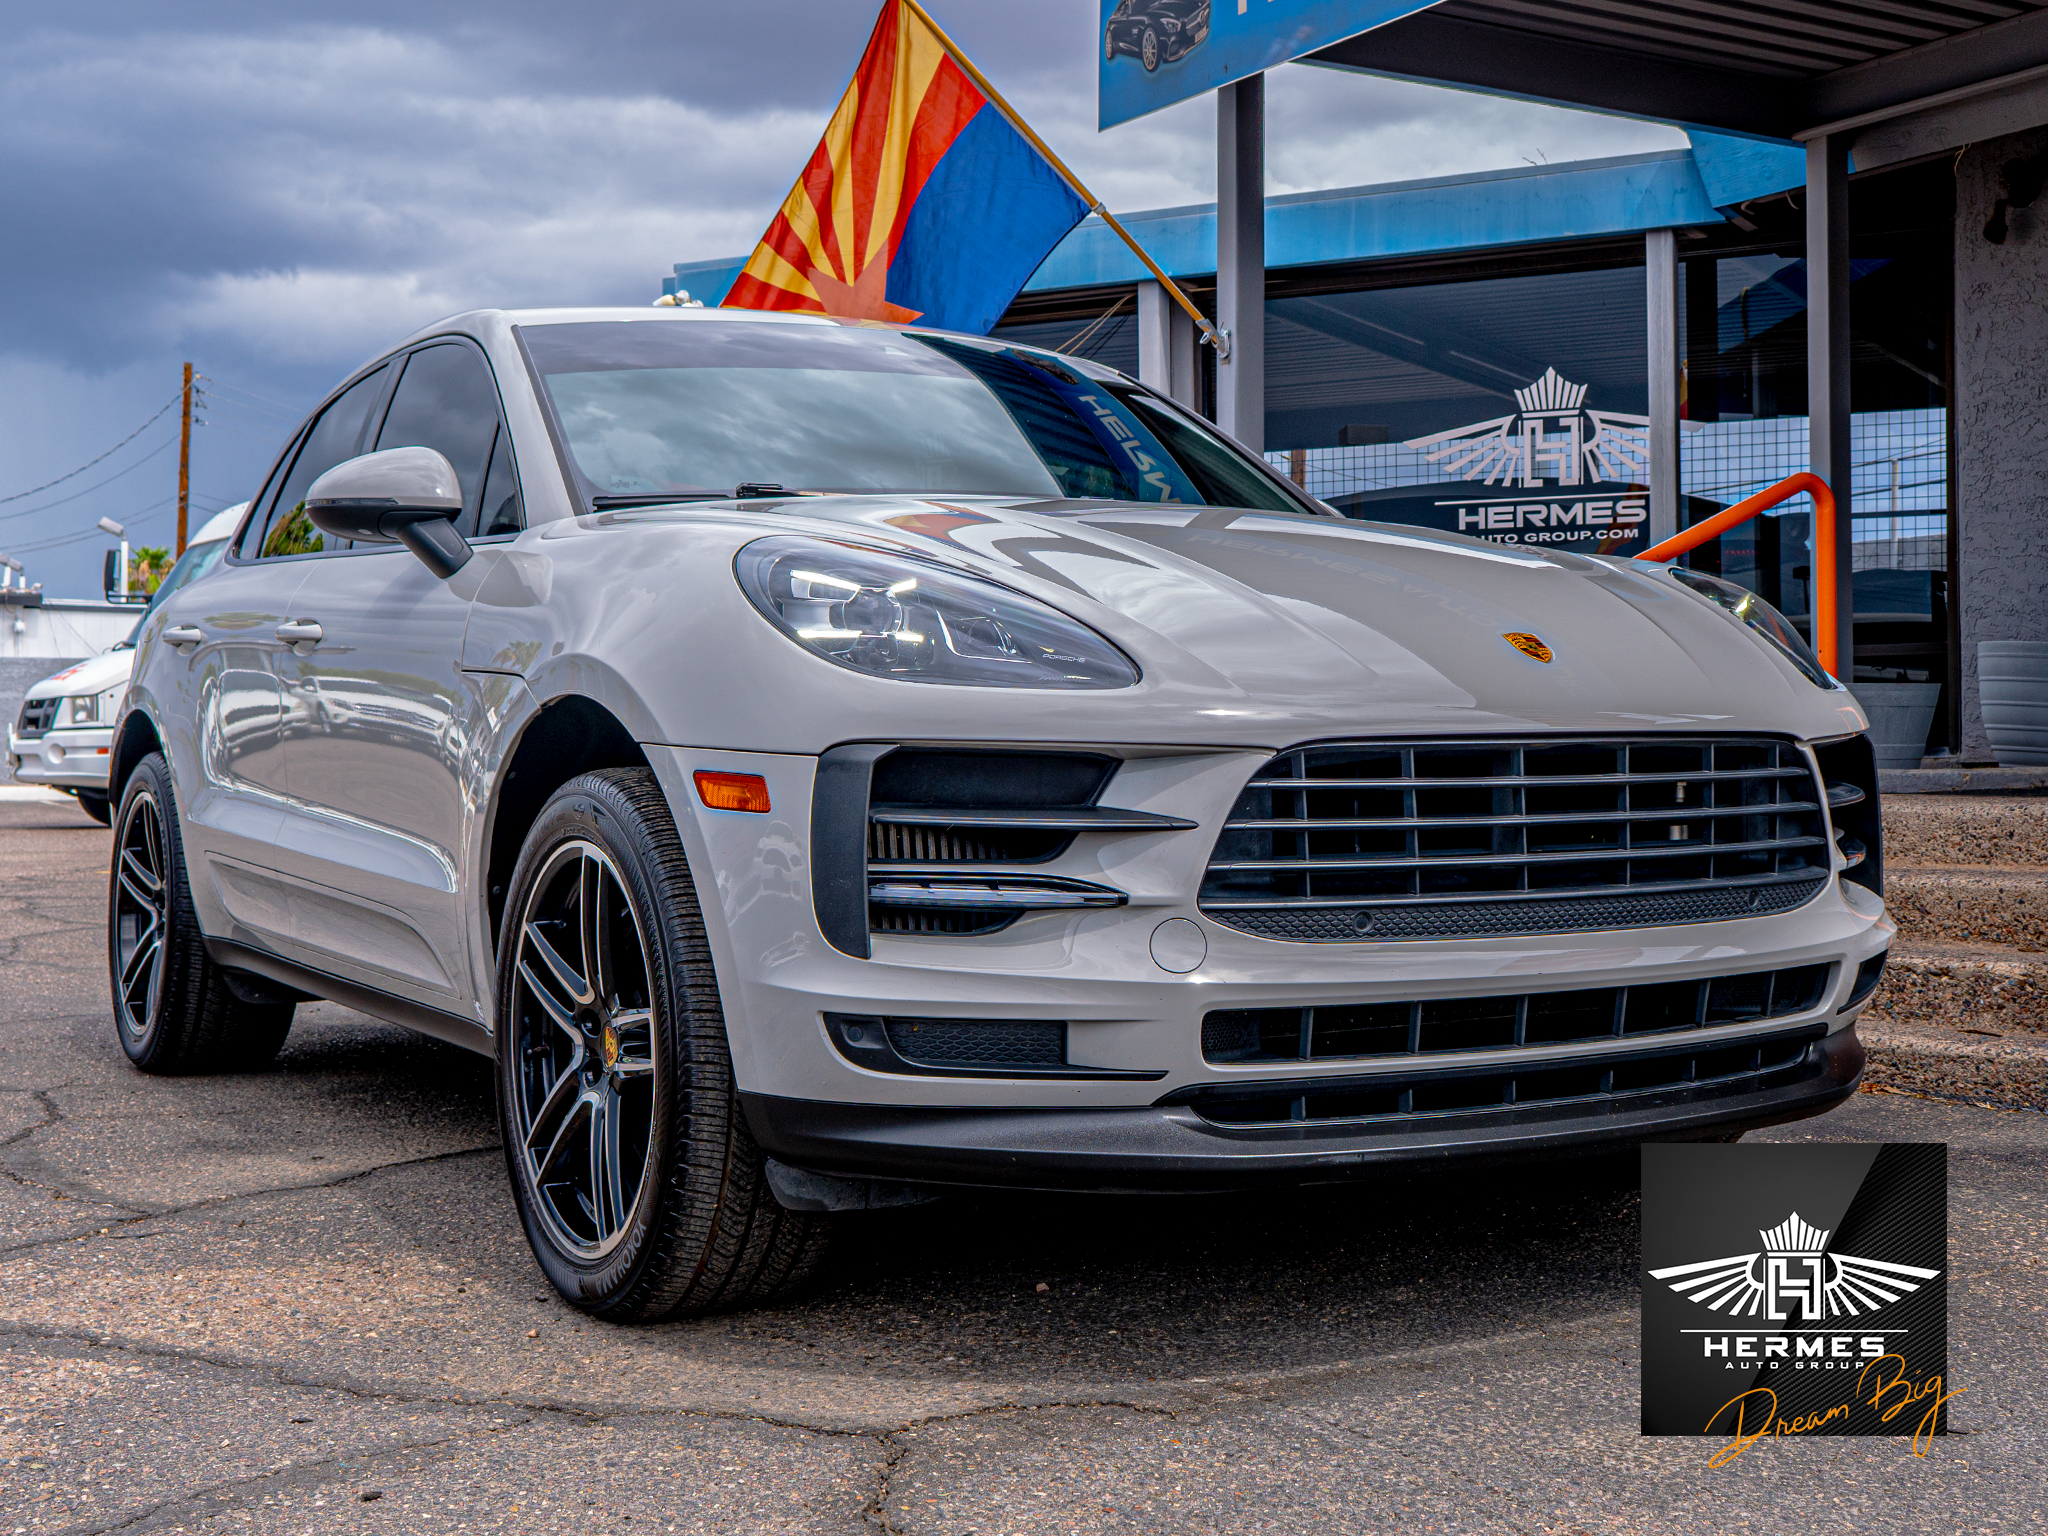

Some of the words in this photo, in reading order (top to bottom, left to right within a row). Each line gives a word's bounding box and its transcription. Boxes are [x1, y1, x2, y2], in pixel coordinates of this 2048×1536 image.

[1459, 499, 1647, 530] HERMES
[1474, 534, 1519, 544] UTO
[1524, 528, 1639, 543] GROUP.COM
[1042, 653, 1086, 663] PORSCHE
[595, 1219, 647, 1297] YOKOHAMA
